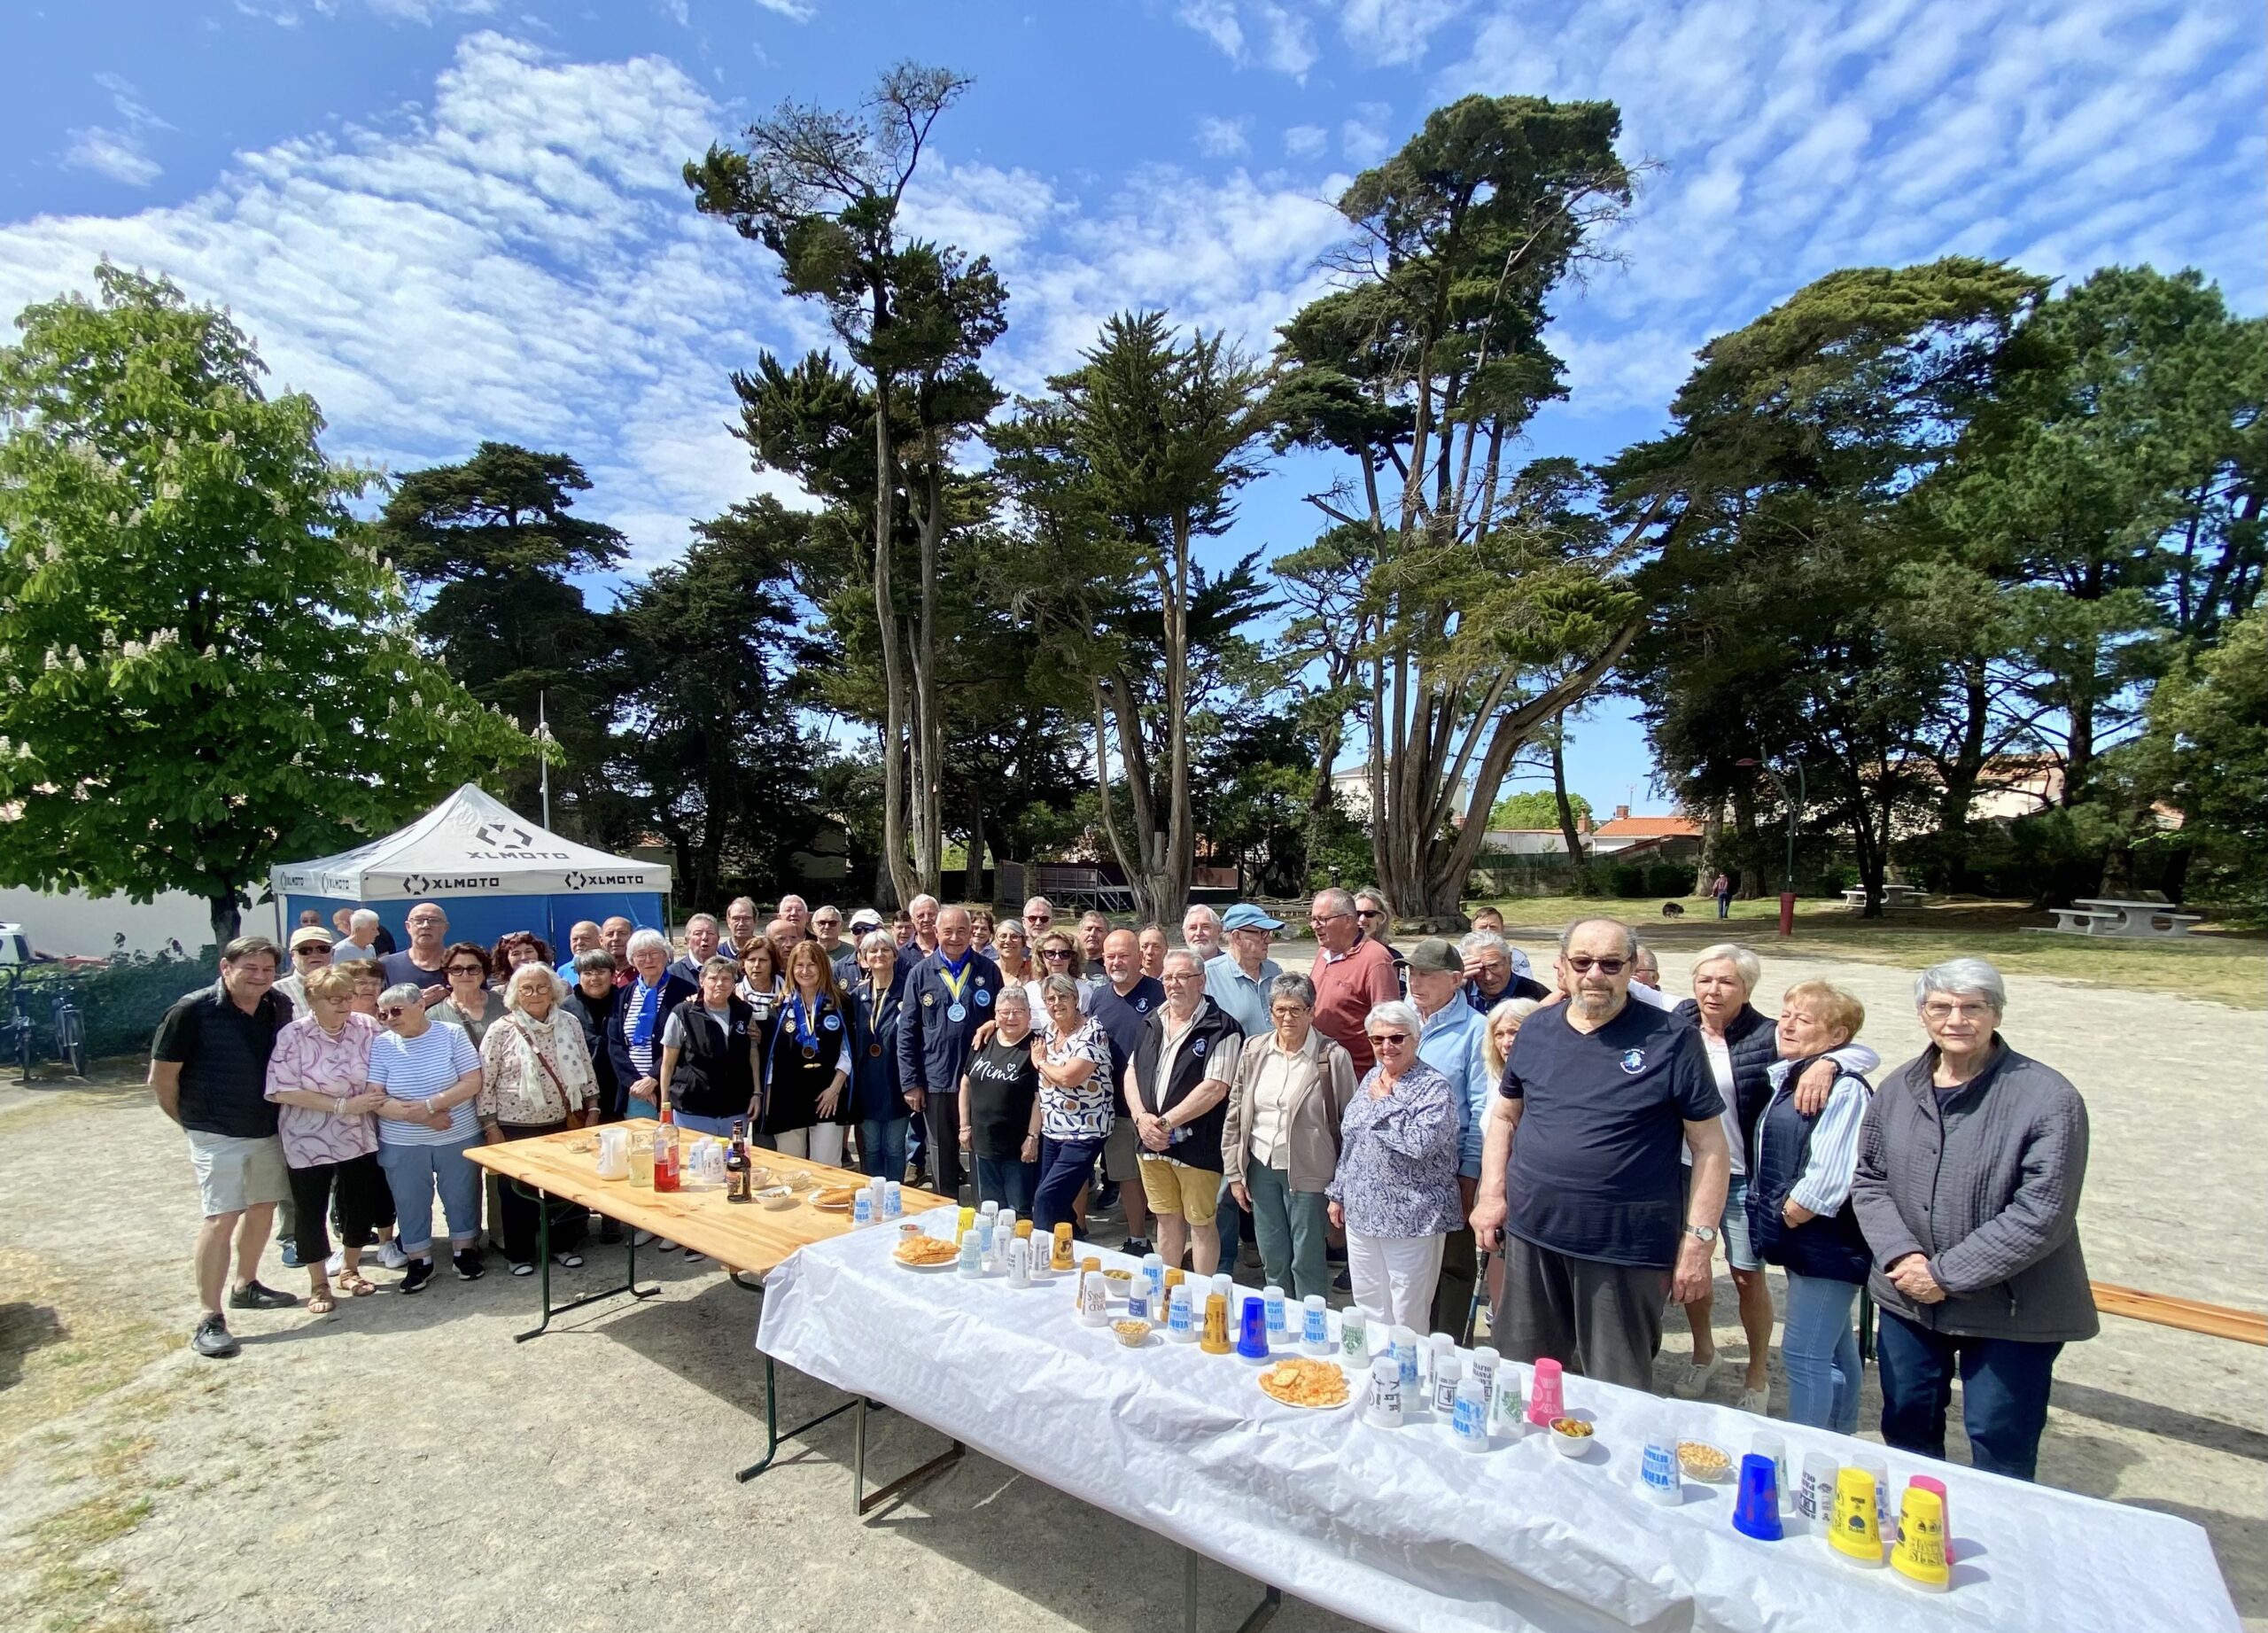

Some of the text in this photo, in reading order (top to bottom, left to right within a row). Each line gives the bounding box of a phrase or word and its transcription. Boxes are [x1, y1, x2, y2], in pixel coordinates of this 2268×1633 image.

[465, 851, 570, 859] XLMOTO
[431, 877, 500, 889] XLMOTO
[588, 875, 644, 885] XLMOTO
[968, 1056, 1020, 1081] Mimi
